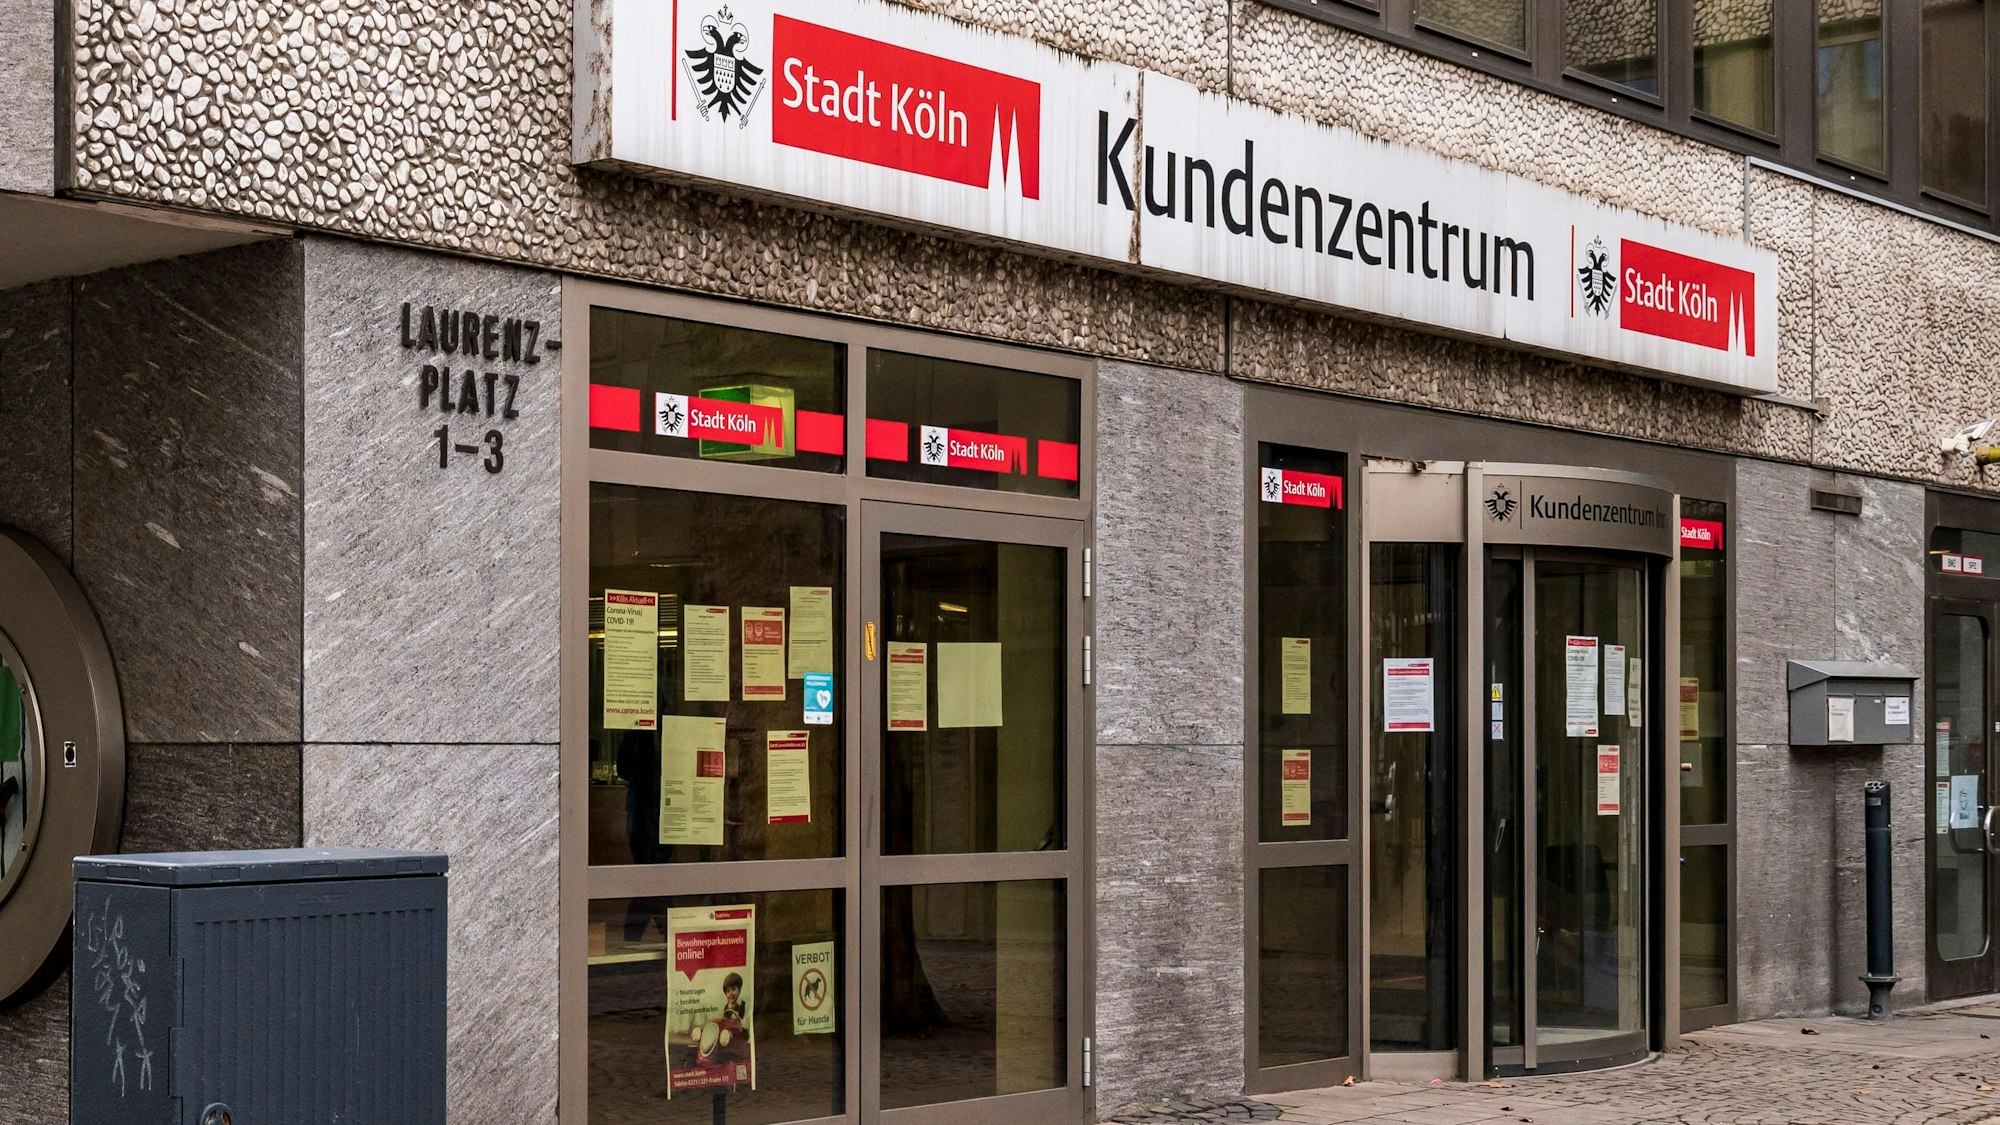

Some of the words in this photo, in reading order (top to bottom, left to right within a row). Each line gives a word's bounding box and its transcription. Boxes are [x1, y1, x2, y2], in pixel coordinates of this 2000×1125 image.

[783, 57, 882, 127] Stadt
[891, 83, 968, 148] Köln
[1097, 109, 1535, 301] Kundenzentrum
[1625, 267, 1674, 313] Stadt
[1678, 280, 1718, 323] Köln
[401, 302, 562, 364] LAURENZ-
[419, 364, 520, 419] PLATZ
[690, 409, 726, 430] Stadt
[727, 413, 757, 434] Köln
[950, 440, 979, 459] Stadt
[980, 444, 1005, 462] Köln
[1283, 479, 1306, 496] Stadt
[1306, 482, 1326, 498] Köln
[1530, 494, 1655, 527] Kundenzentrum
[1681, 526, 1697, 540] Stadt
[1697, 527, 1711, 541] Köln
[676, 935, 744, 949] Bewohnerparkausweis
[677, 948, 705, 961] online!
[795, 951, 831, 966] VERBOT
[797, 1016, 807, 1027] für
[808, 1014, 830, 1025] Hunde
